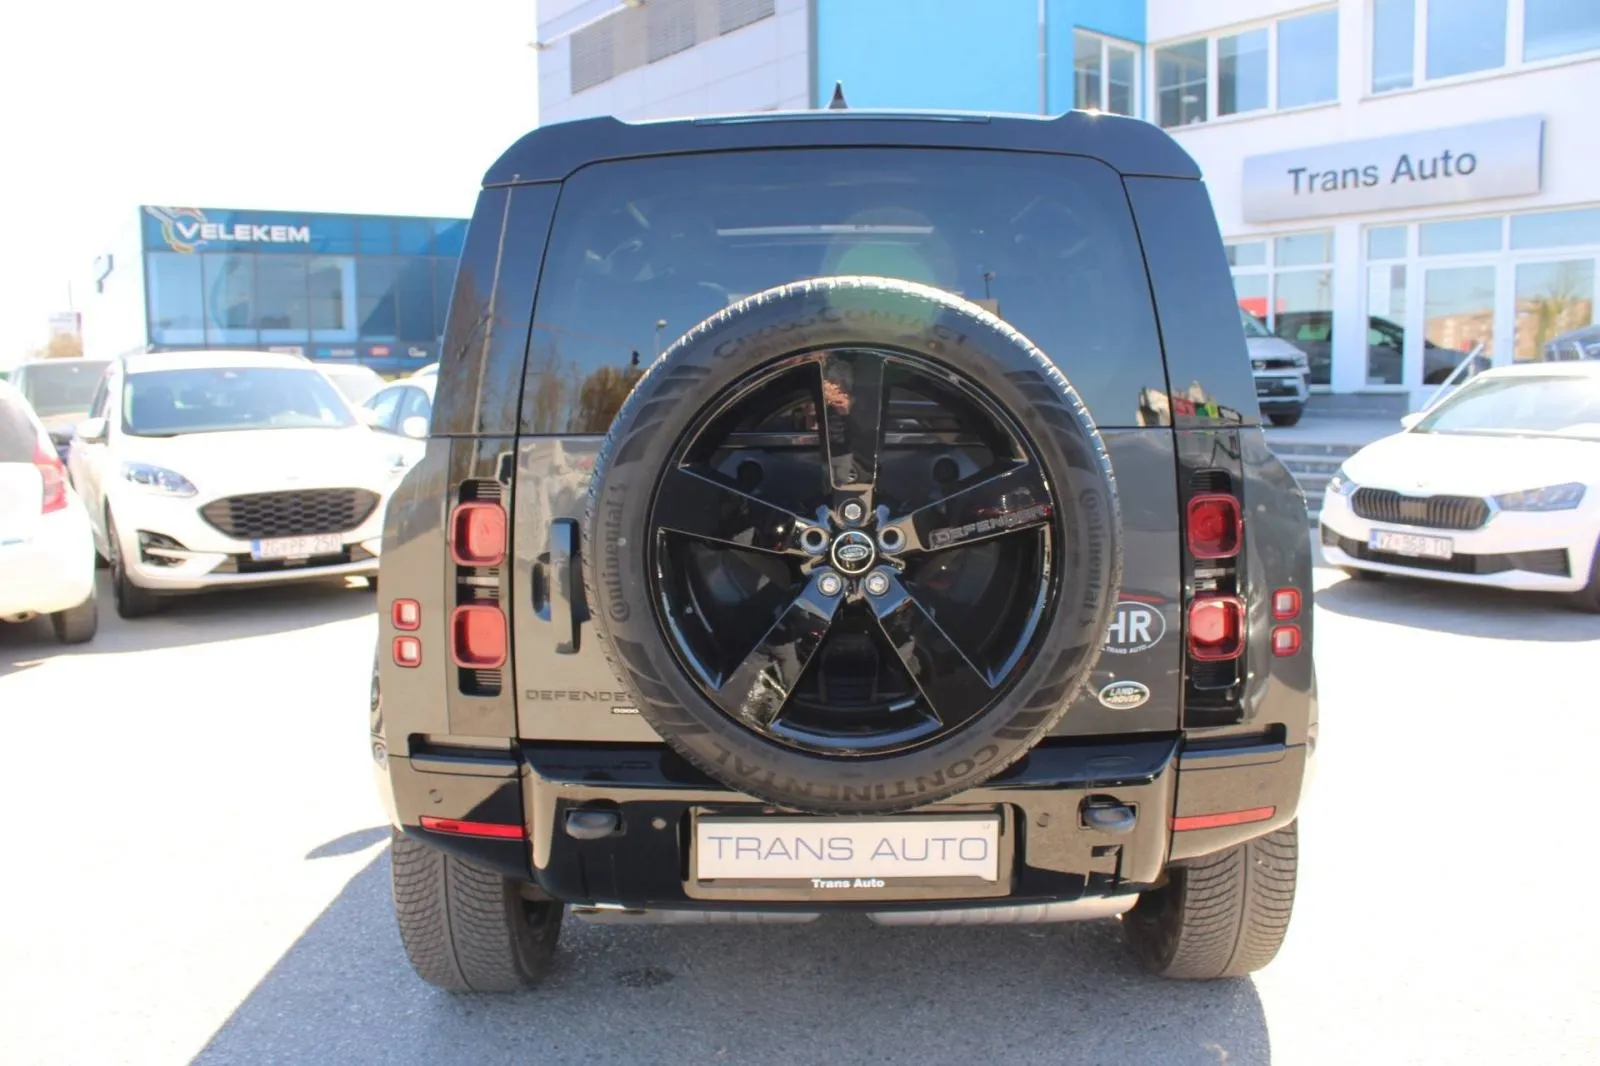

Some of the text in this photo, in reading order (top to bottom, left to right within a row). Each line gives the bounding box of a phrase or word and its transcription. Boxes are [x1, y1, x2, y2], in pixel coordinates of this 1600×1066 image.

[1287, 149, 1478, 196] Trans Auto
[175, 221, 310, 243] VELEKEM
[1105, 611, 1152, 643] HR
[525, 689, 632, 701] DEFENDE
[707, 836, 989, 861] TRANS AUTO
[811, 878, 885, 889] Trans Auto
